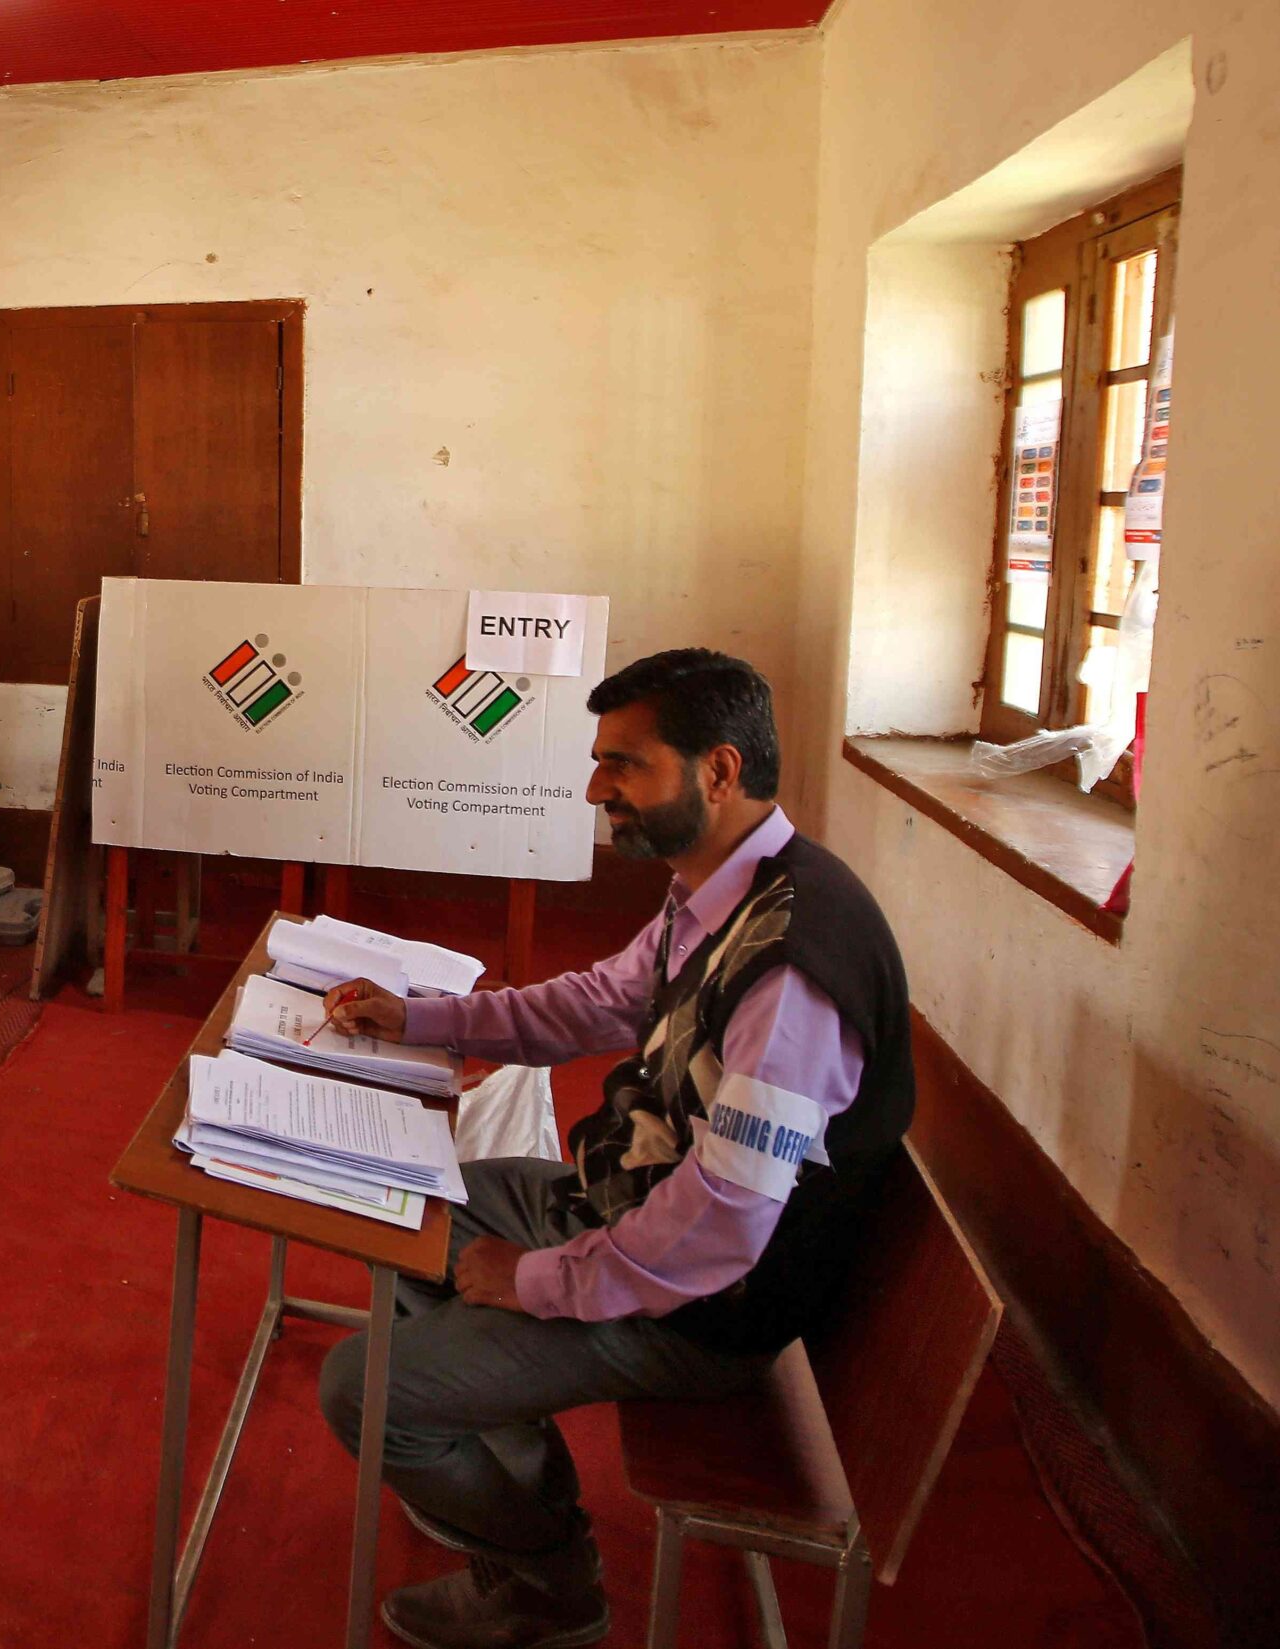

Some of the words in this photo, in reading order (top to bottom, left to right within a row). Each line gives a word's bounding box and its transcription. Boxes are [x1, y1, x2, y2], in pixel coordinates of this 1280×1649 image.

[480, 616, 571, 639] ENTRY
[98, 759, 125, 772] India
[165, 764, 214, 777] Election
[217, 766, 294, 782] Commission
[296, 770, 310, 782] of
[312, 770, 344, 784] India
[188, 783, 228, 798] Voting
[231, 786, 319, 801] Compartment
[382, 776, 434, 790] Election
[438, 780, 518, 796] Commission
[522, 785, 536, 796] of
[540, 786, 572, 798] India
[406, 797, 448, 813] Voting
[452, 800, 546, 817] Compartment
[772, 1125, 813, 1165] OFFIC
